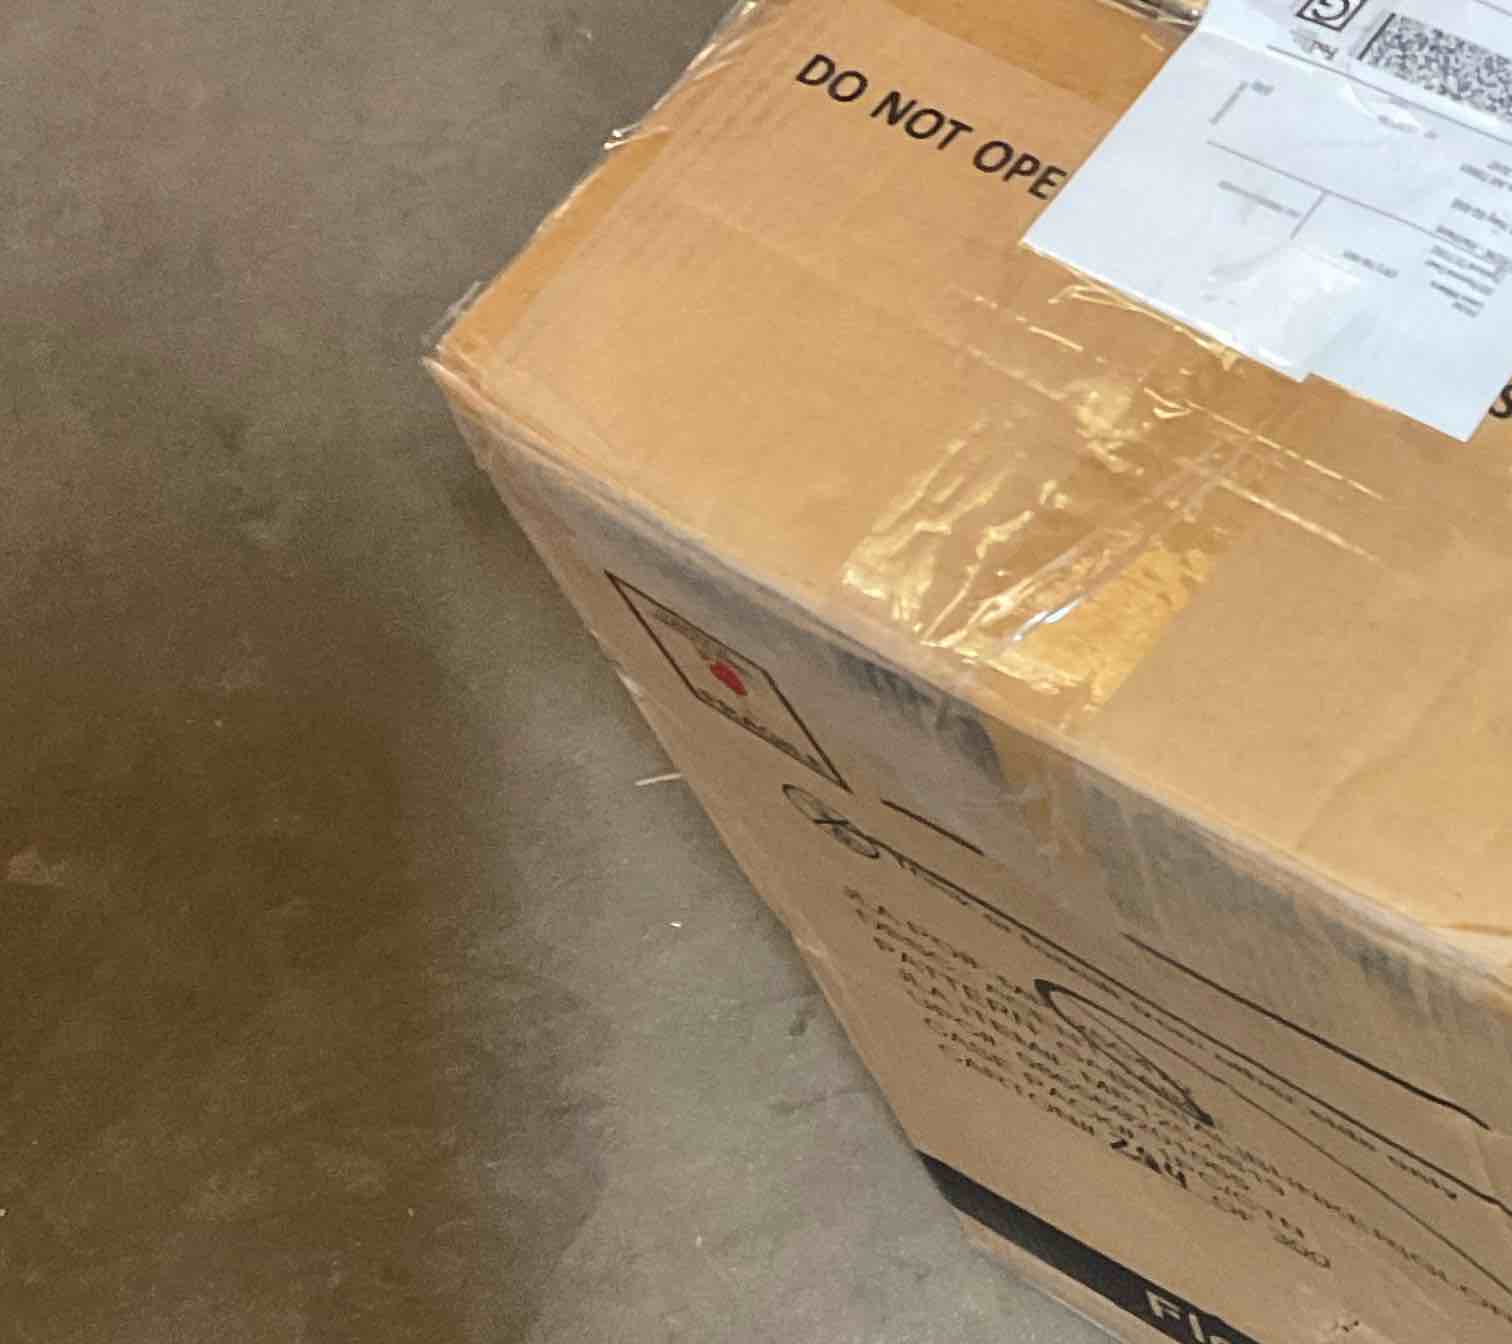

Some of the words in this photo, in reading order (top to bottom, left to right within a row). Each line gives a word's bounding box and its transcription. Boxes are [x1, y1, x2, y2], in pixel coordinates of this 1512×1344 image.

[796, 54, 868, 102] DO
[869, 91, 973, 151] NOT
[972, 140, 1067, 201] OPE
